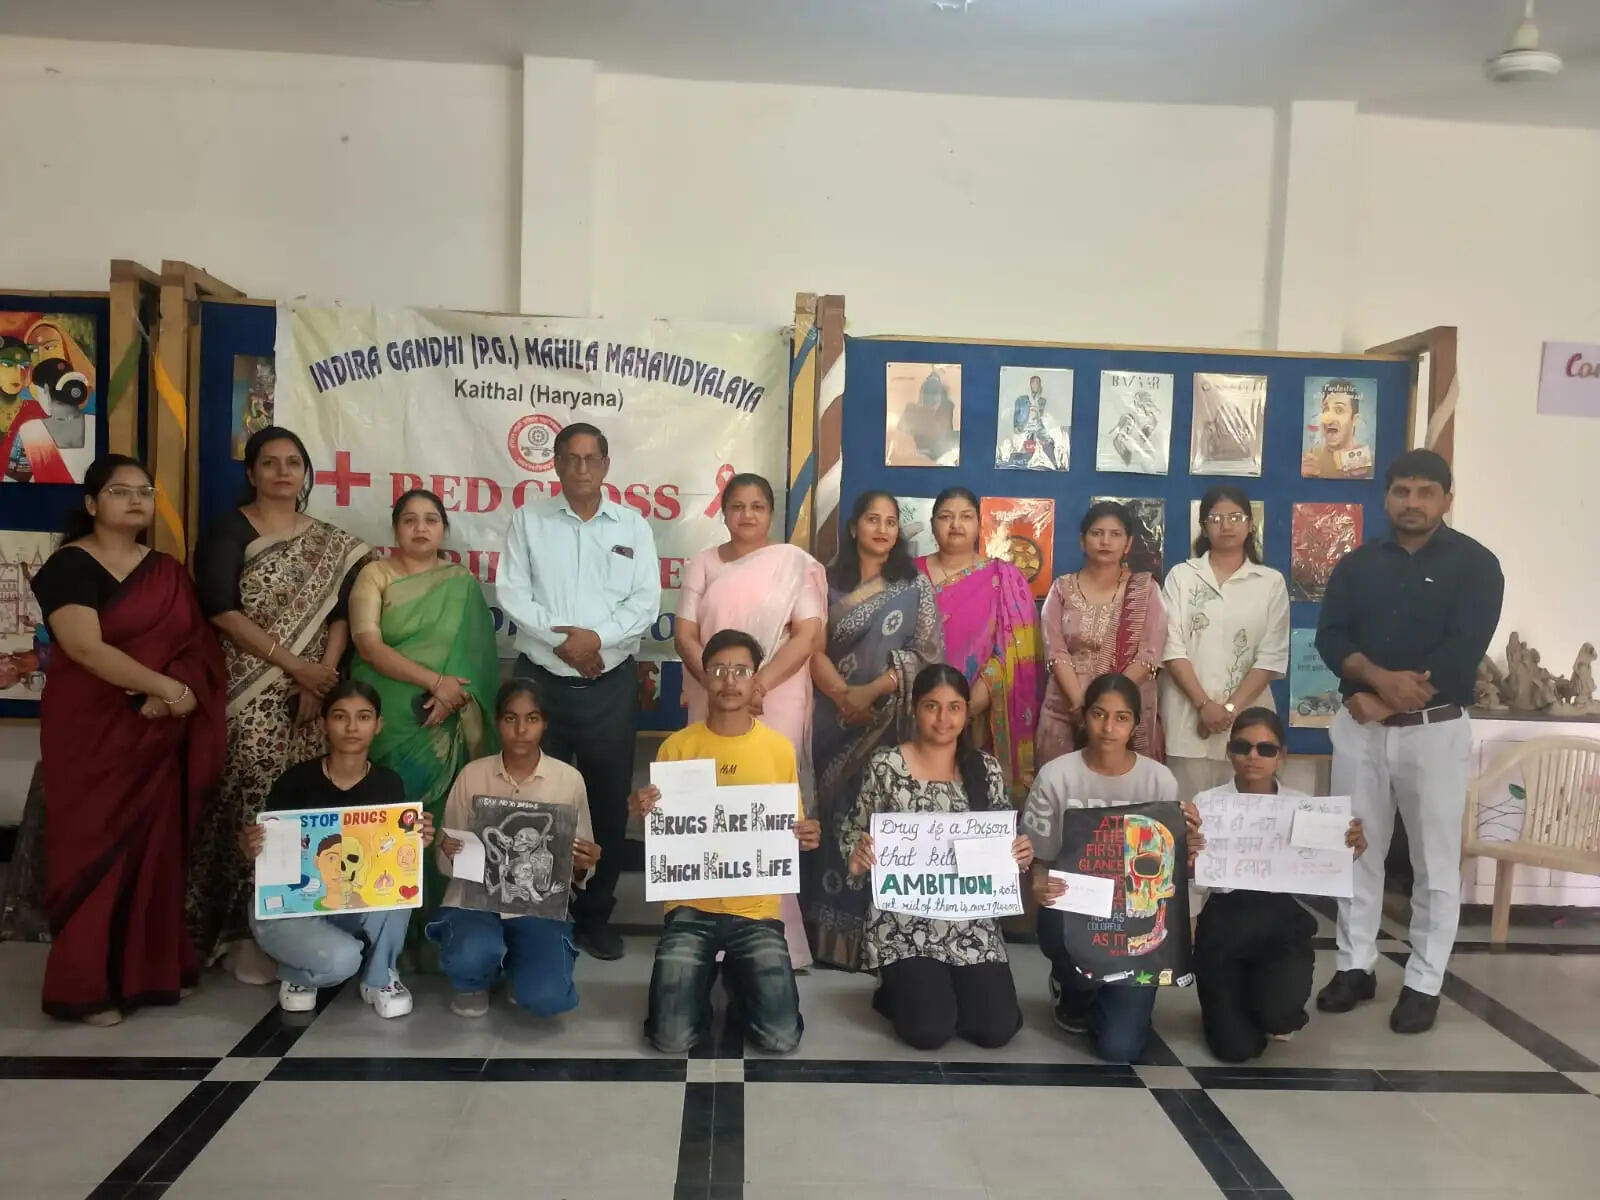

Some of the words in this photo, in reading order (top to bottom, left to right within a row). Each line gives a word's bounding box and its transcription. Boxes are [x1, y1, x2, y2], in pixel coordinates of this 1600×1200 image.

[309, 346, 382, 394] INDIRA
[386, 335, 464, 373] GANDHI
[471, 333, 519, 370] (P.G.)
[524, 337, 599, 373] MAHILA
[605, 342, 766, 413] MAHAVIDYALAYA
[454, 378, 523, 402] Kaithal
[530, 383, 624, 413] (Haryana)
[300, 813, 339, 828] STOP
[343, 810, 387, 826] DRUGS
[650, 807, 707, 836] DRUGS
[712, 804, 748, 833] ARE
[880, 819, 919, 841] Drug
[928, 820, 945, 840] is
[949, 823, 961, 835] a
[963, 818, 1010, 836] Poison
[1092, 829, 1124, 843] THE
[880, 846, 917, 867] that
[1086, 843, 1123, 857] FIRST
[1079, 857, 1124, 871] GLANCE
[880, 873, 997, 898] AMBITION,
[1091, 933, 1108, 946] AS
